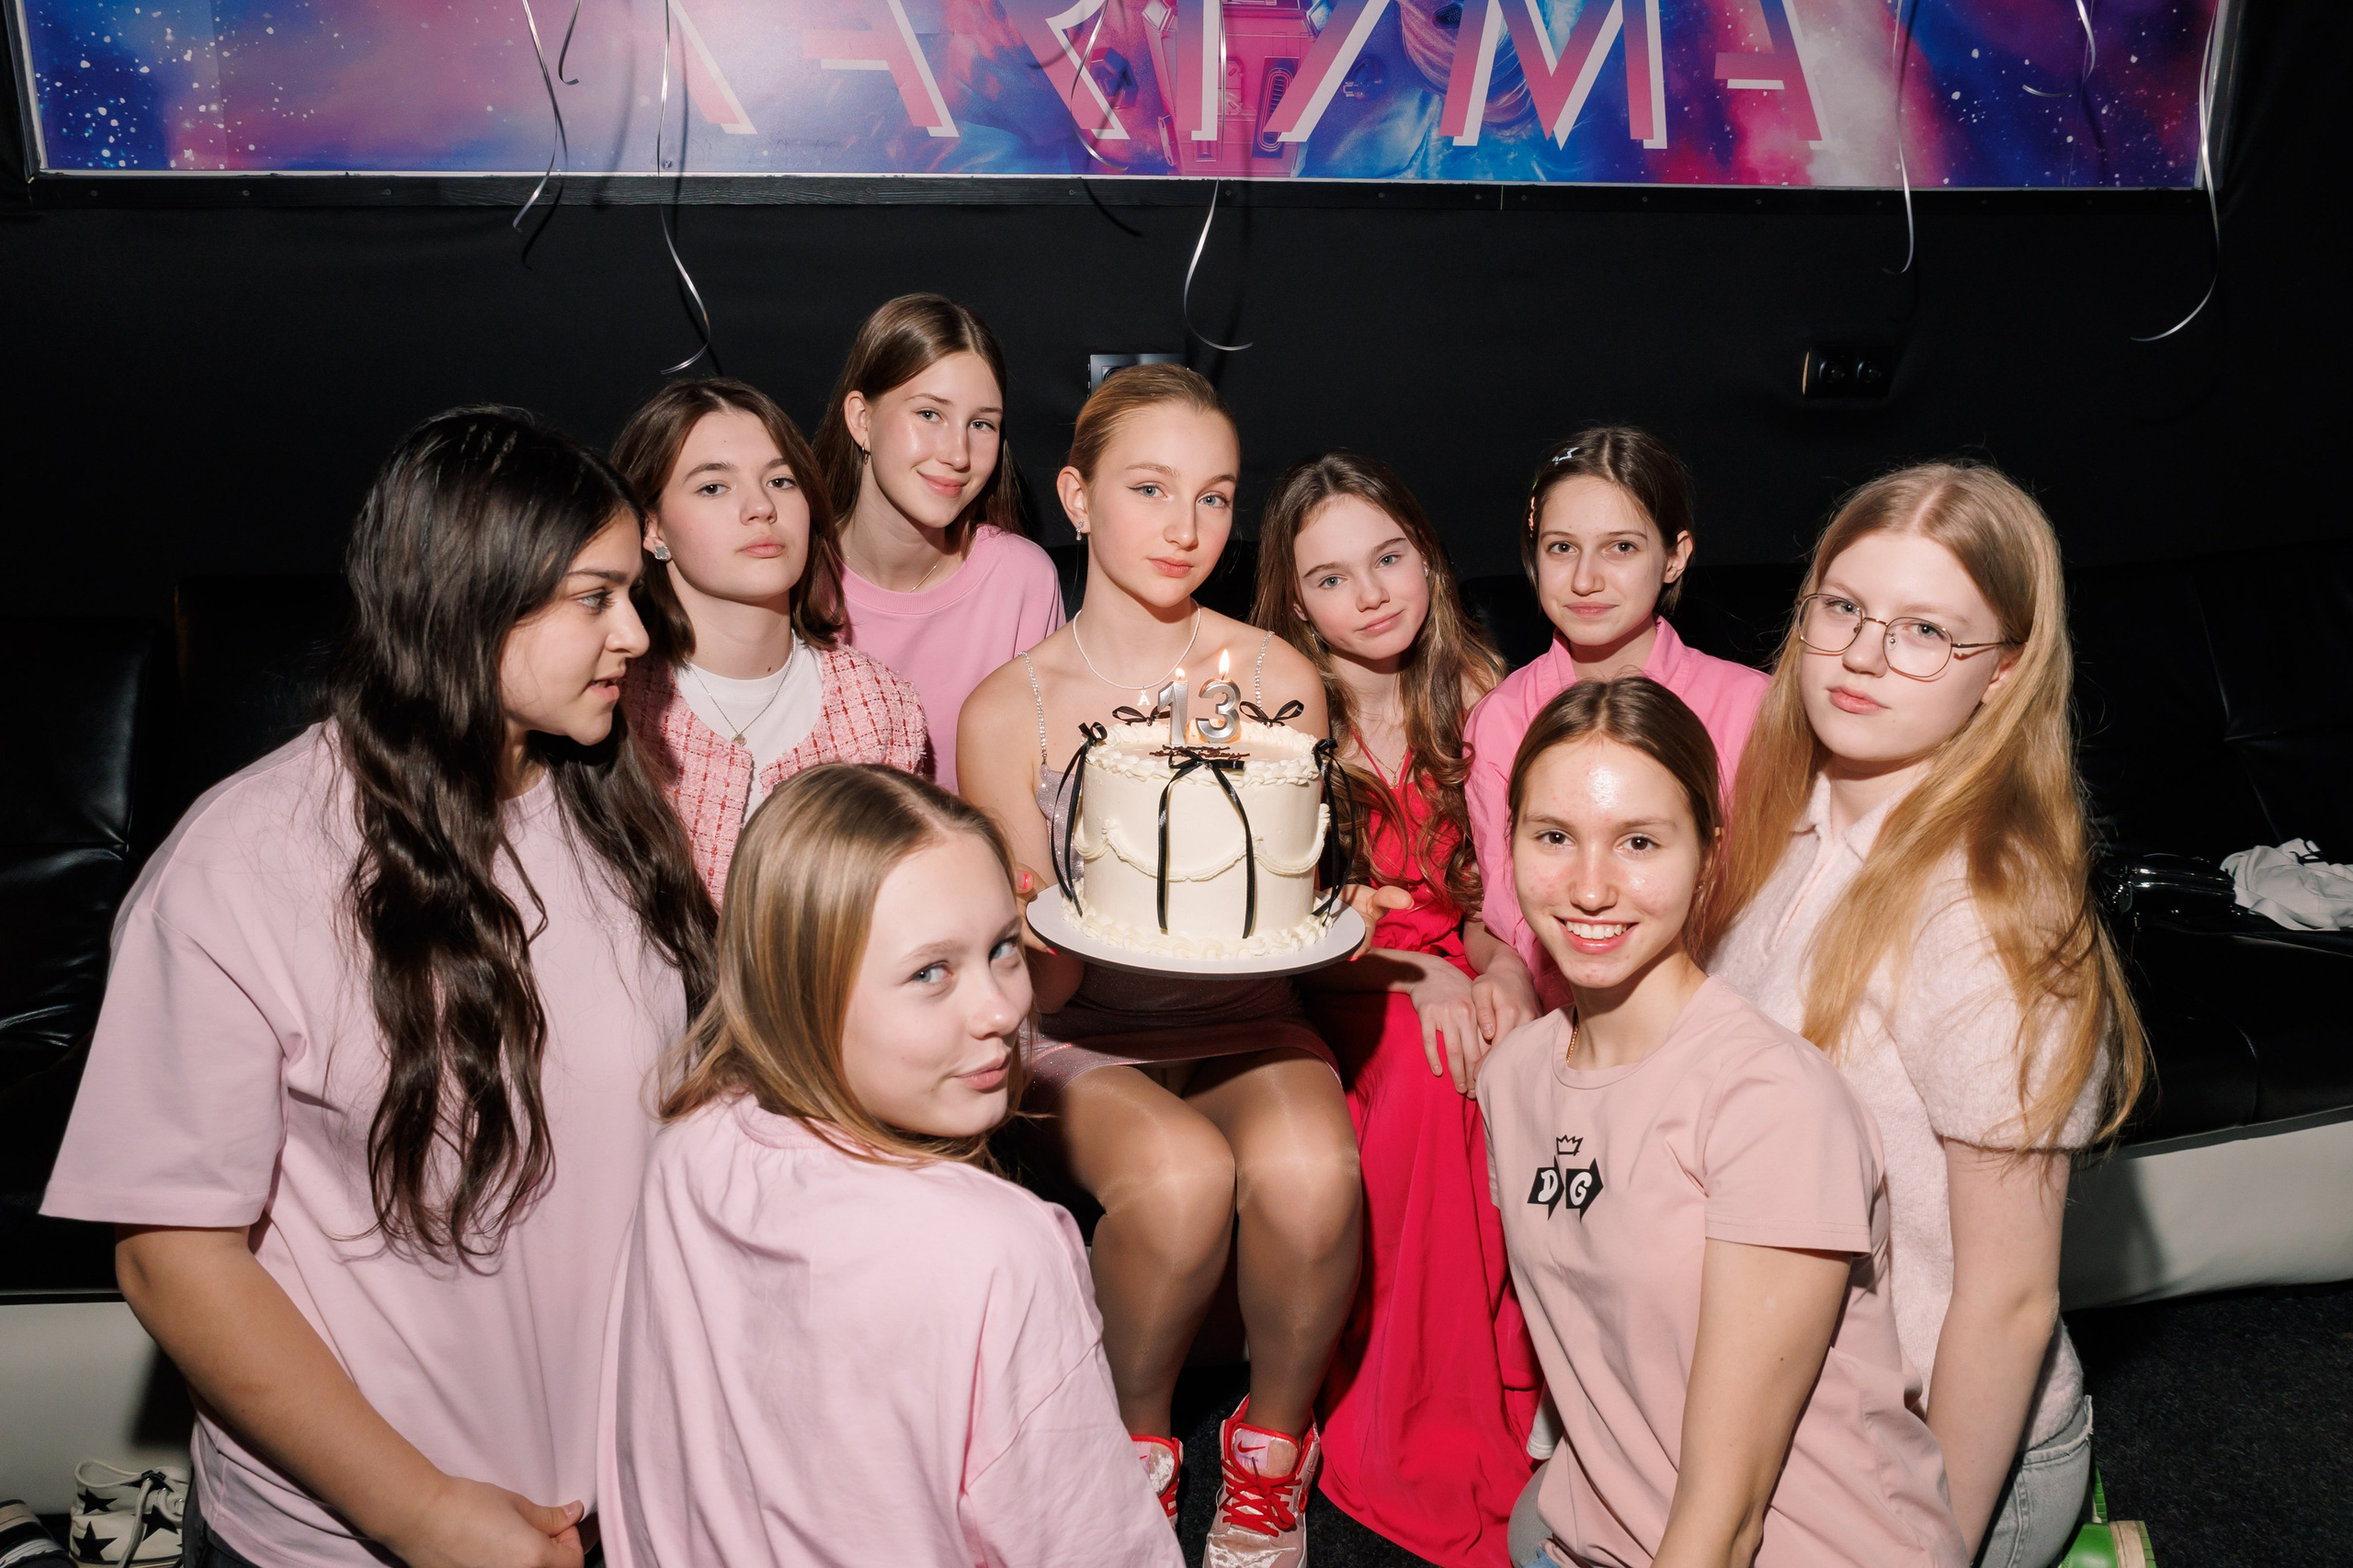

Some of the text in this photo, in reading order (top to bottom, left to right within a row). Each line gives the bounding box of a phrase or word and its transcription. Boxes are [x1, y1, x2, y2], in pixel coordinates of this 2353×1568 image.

[1137, 693, 1151, 706] A
[1158, 678, 1242, 745] 13
[1536, 1167, 1594, 1207] DG
